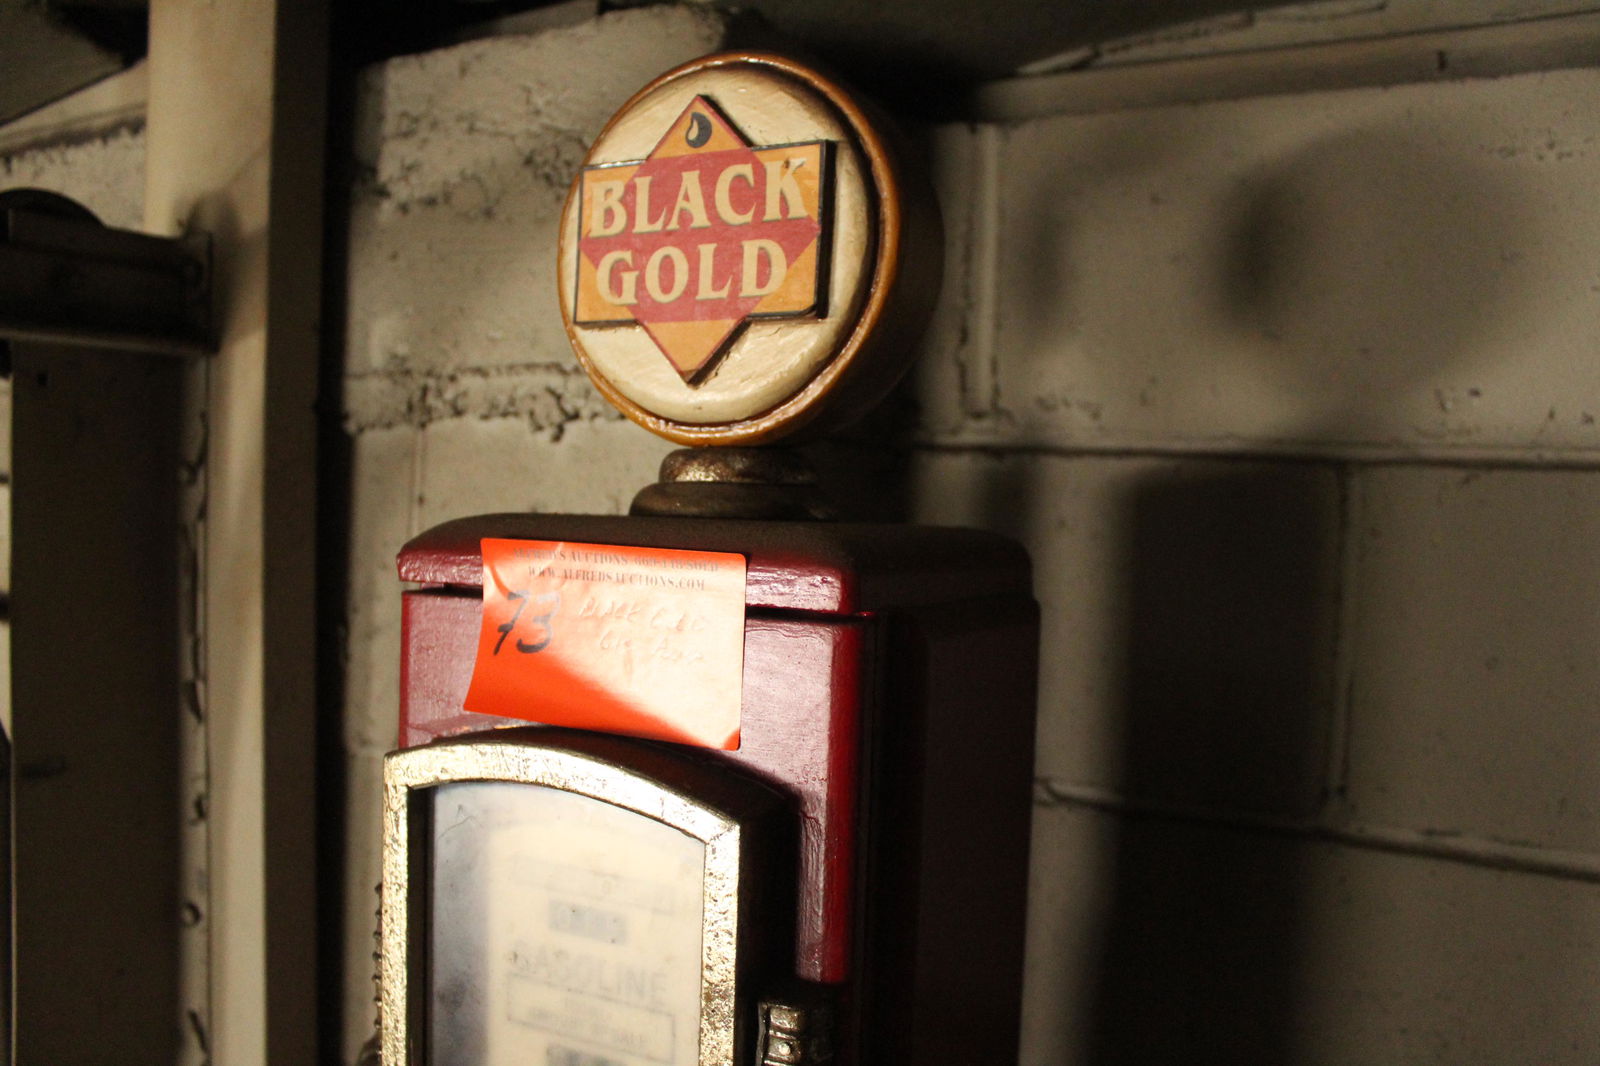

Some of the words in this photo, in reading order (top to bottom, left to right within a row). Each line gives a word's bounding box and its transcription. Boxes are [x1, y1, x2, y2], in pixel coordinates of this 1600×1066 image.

[588, 157, 808, 238] BLACK
[596, 239, 787, 306] GOLD
[493, 590, 560, 656] 73
